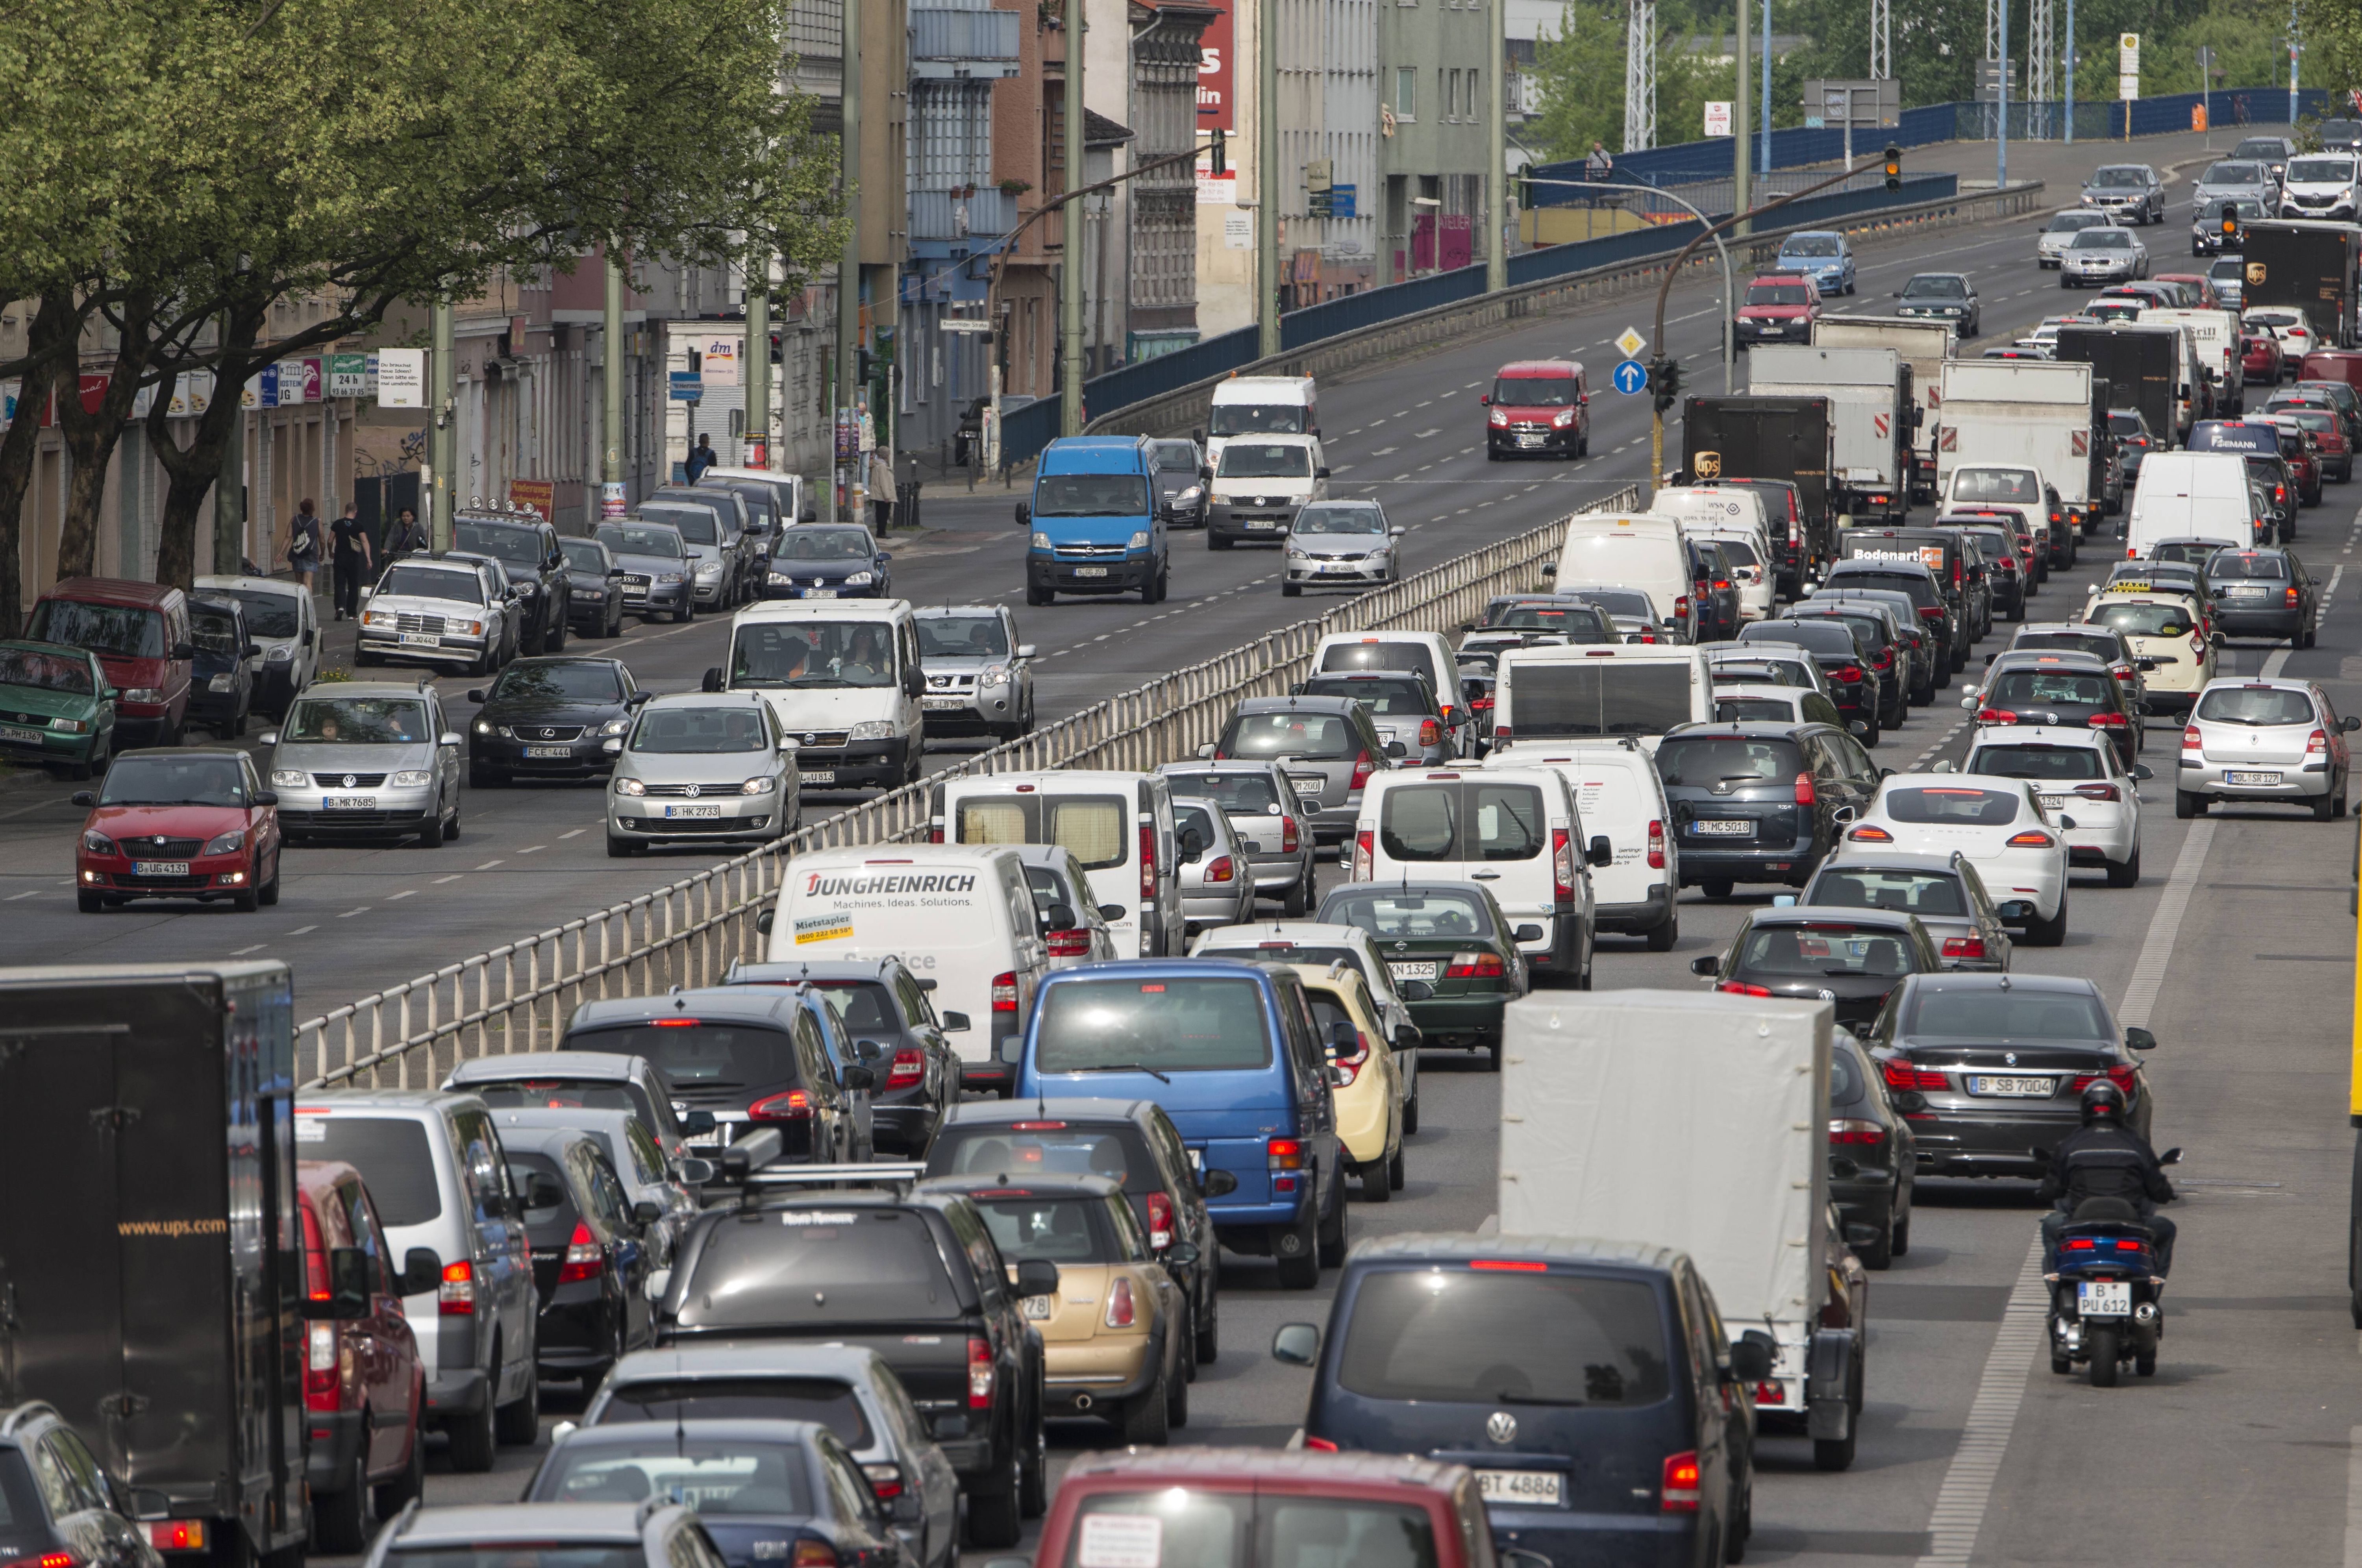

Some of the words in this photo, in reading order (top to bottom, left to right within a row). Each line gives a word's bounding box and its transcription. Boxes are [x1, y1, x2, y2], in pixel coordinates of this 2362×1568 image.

[711, 341, 731, 353] dm
[339, 375, 350, 384] 24
[353, 375, 358, 384] h
[1697, 460, 1718, 477] ups
[1854, 549, 1918, 561] Bodenart
[0, 728, 5, 736] B
[23, 732, 41, 741] 1367
[2233, 773, 2247, 782] MOL
[2252, 774, 2261, 782] SR
[2264, 774, 2277, 783] 127
[1303, 782, 1318, 791] 200
[329, 799, 334, 807] B
[340, 798, 351, 807] MR
[353, 797, 373, 806] 7685
[2041, 797, 2061, 806] 1324
[1699, 823, 1705, 831] B
[1711, 823, 1723, 831] MC
[1725, 823, 1748, 832] 5018
[138, 864, 144, 873] B
[150, 864, 162, 872] UG
[164, 863, 187, 873] 4131
[806, 875, 975, 897] JUNGHEINRICH
[833, 898, 886, 910] Machines.
[887, 898, 917, 908] Ideas.
[920, 897, 972, 907] Solutions.
[795, 915, 850, 931] Mietstapler
[1388, 964, 1404, 975] KN
[1407, 963, 1435, 974] 1325
[1979, 1079, 1987, 1091] B
[1997, 1079, 2014, 1091] SB
[2018, 1080, 2049, 1091] 7004
[118, 1219, 227, 1238] www.ups.com
[2096, 1285, 2105, 1297] B
[2082, 1300, 2098, 1311] PU
[2103, 1299, 2127, 1312] 612
[1509, 1476, 1557, 1495] 4886
